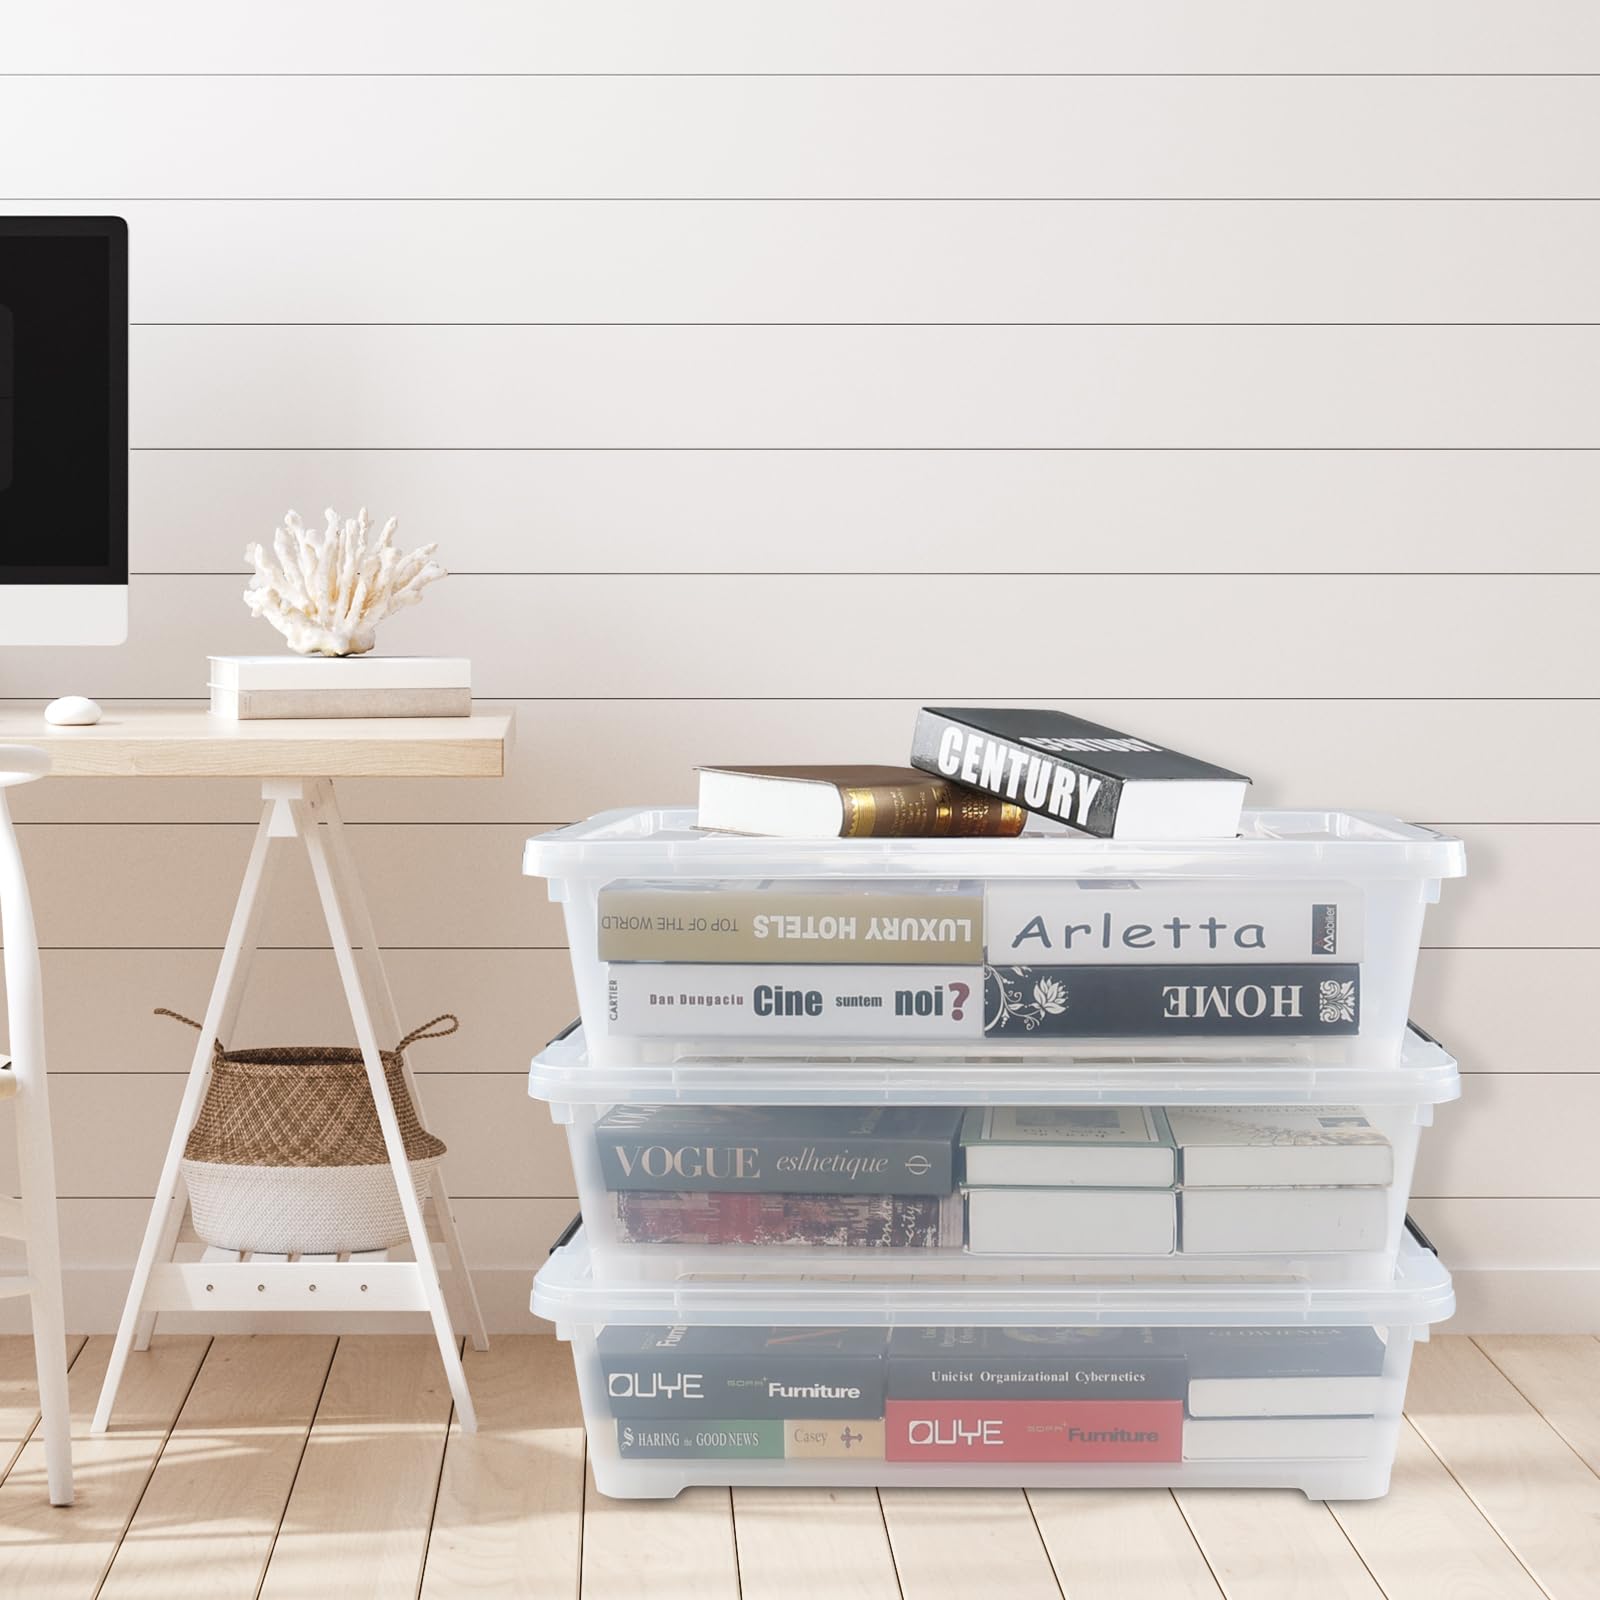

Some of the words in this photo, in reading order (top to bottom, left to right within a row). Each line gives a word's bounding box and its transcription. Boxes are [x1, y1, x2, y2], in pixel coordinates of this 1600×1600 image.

[937, 726, 1102, 826] CENTURY
[601, 915, 655, 931] WORLD
[656, 917, 685, 931] THE
[686, 918, 708, 932] OF
[711, 918, 739, 932] TOP
[753, 914, 856, 941] HOTELS
[866, 916, 972, 942] LUXURY
[1011, 912, 1266, 949] Arletta
[608, 979, 618, 1021] CARTIER
[649, 994, 676, 1006] Dan
[680, 994, 744, 1007] Dungaciu
[753, 985, 823, 1017] Cine
[835, 995, 883, 1008] suntem
[895, 982, 970, 1021] noi?
[1162, 984, 1303, 1018] HOME
[615, 1145, 761, 1178] VOGUE
[608, 1372, 704, 1399] OUYE
[931, 1370, 974, 1383] Unicist
[980, 1370, 1069, 1384] Organizational
[1075, 1370, 1146, 1385] Cybernetics
[768, 1383, 861, 1399] Furniture
[696, 1432, 726, 1447] GOOD
[728, 1432, 759, 1447] NEWS
[794, 1428, 828, 1446] Casey
[908, 1419, 1004, 1445] OUYE
[1068, 1427, 1159, 1442] Furniture
